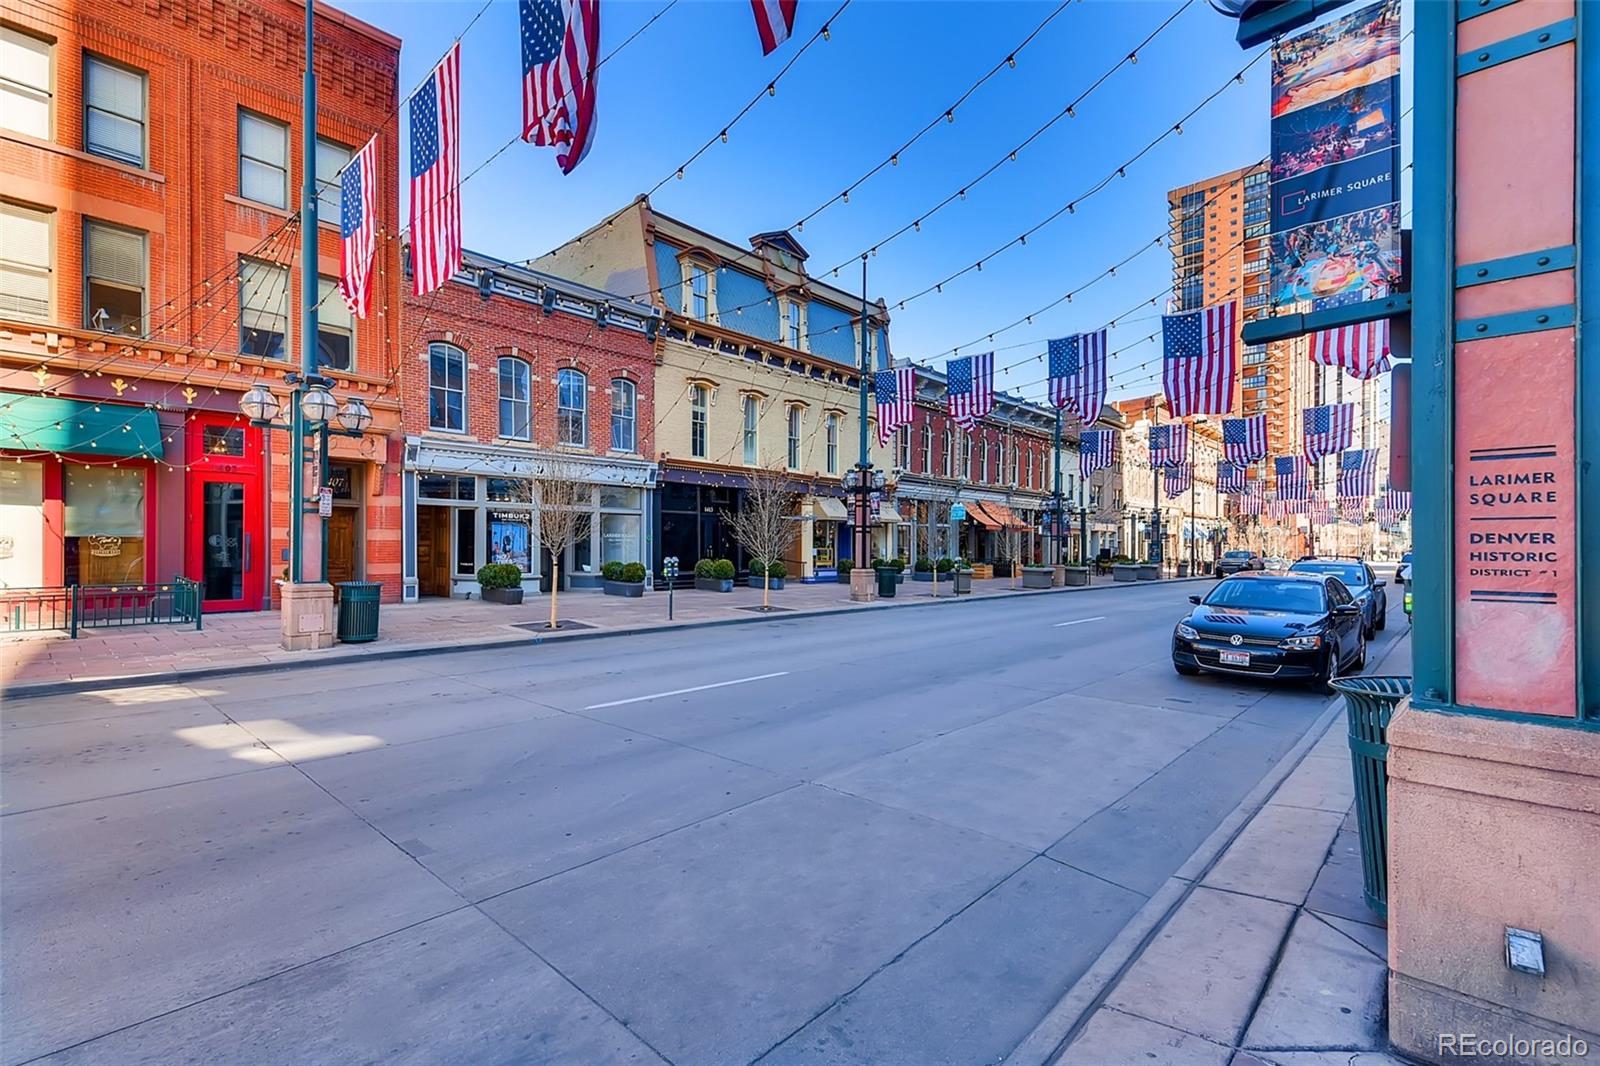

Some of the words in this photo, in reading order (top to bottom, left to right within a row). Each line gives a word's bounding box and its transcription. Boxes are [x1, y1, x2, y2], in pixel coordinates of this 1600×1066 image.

[1298, 186, 1343, 205] LARIMER
[1347, 172, 1392, 192] SQUARE
[1469, 471, 1556, 487] LARIMER
[1469, 491, 1557, 507] SQUARE
[492, 512, 531, 520] TIMBUK2
[1469, 532, 1556, 544] DENVER
[1469, 551, 1558, 563] HISTORIC
[1469, 568, 1532, 577] DISTRICT
